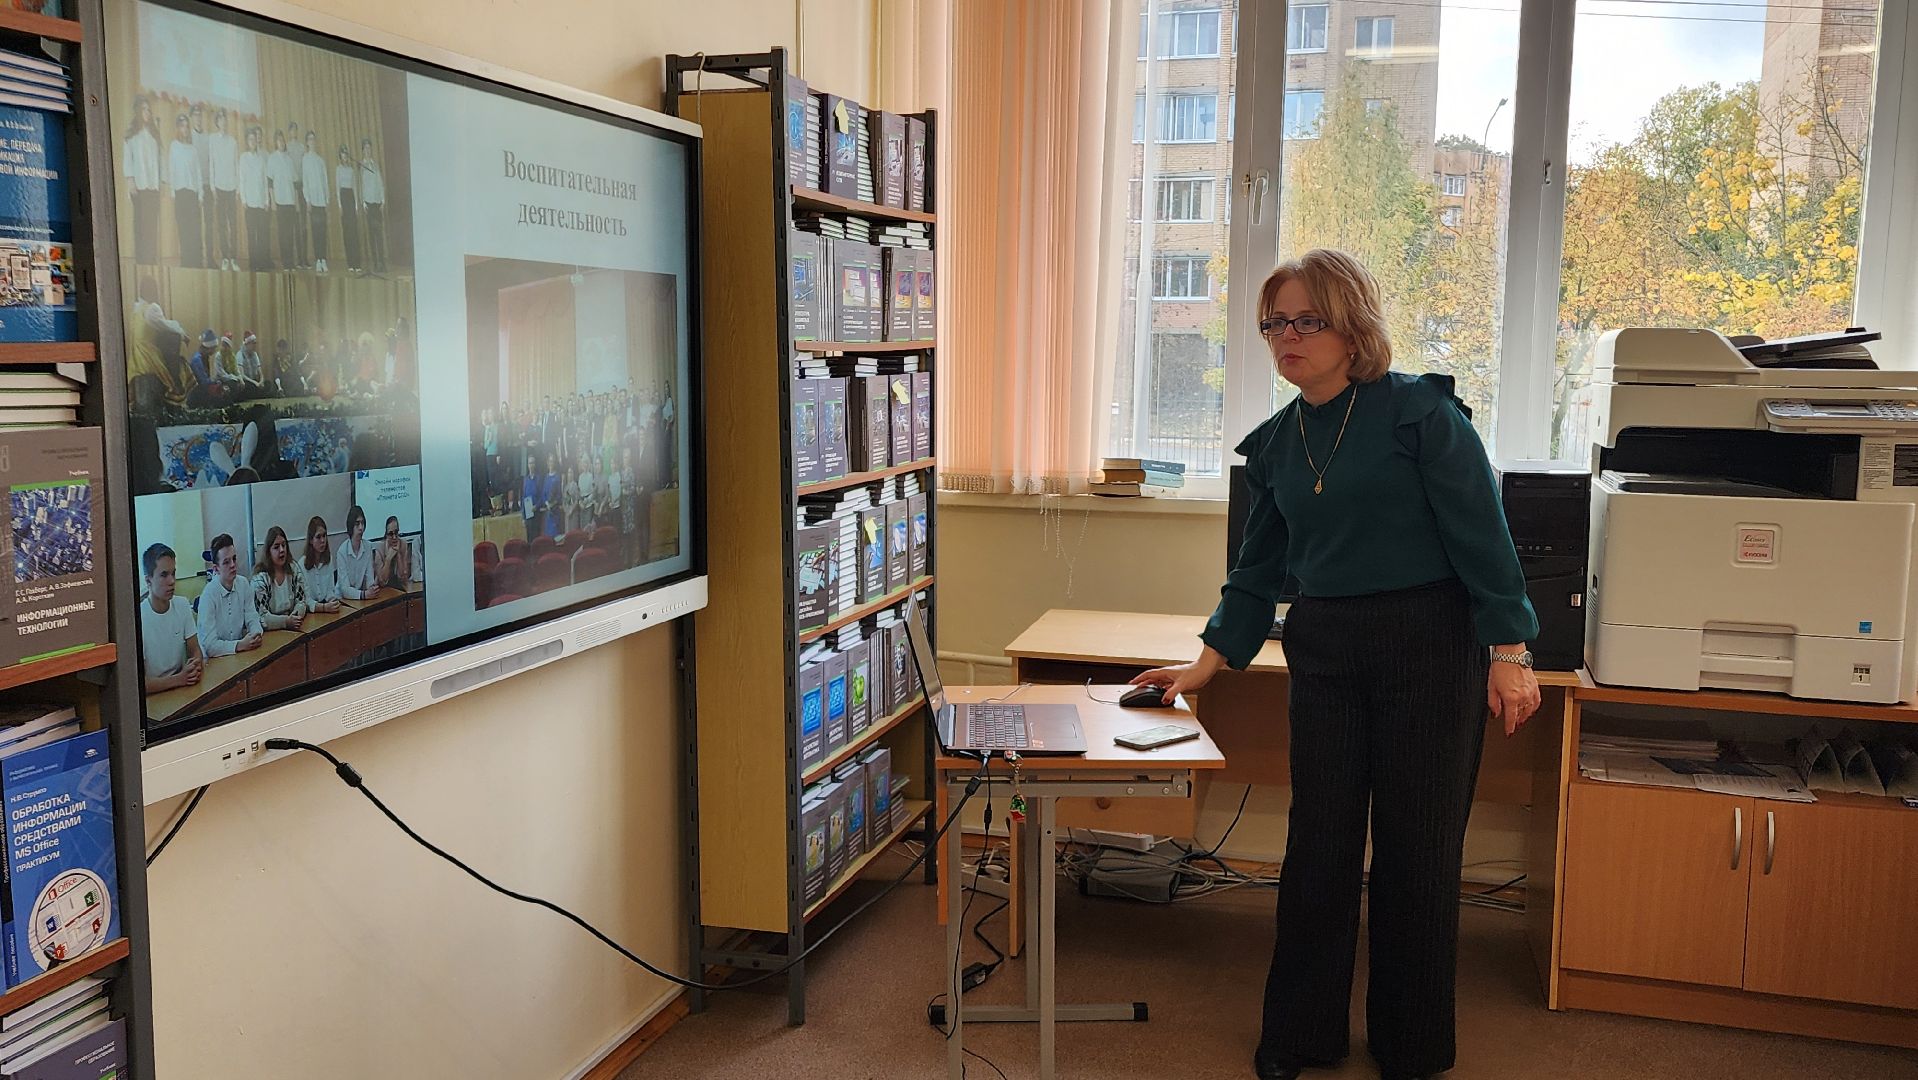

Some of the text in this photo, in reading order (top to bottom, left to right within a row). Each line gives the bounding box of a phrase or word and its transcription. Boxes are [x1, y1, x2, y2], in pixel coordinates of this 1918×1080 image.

[10, 139, 42, 153] ПЕРЕДАЧА
[14, 165, 58, 180] ИНФОРМАЦИИ
[503, 150, 638, 201] Воспитательная
[517, 202, 628, 237] деятельность
[16, 601, 96, 623] ИНФОРМАЦИОННЫЕ
[17, 618, 69, 636] ТЕХНОЛОГИИ
[12, 793, 71, 821] ОБРАБОТКА
[13, 801, 87, 834] ИНФОРМАЦИИ
[14, 815, 82, 847] СРЕДСТВАМИ
[15, 838, 60, 860] MS Office
[16, 851, 60, 873] ПРАКТИКУМ
[57, 878, 77, 893] Office
